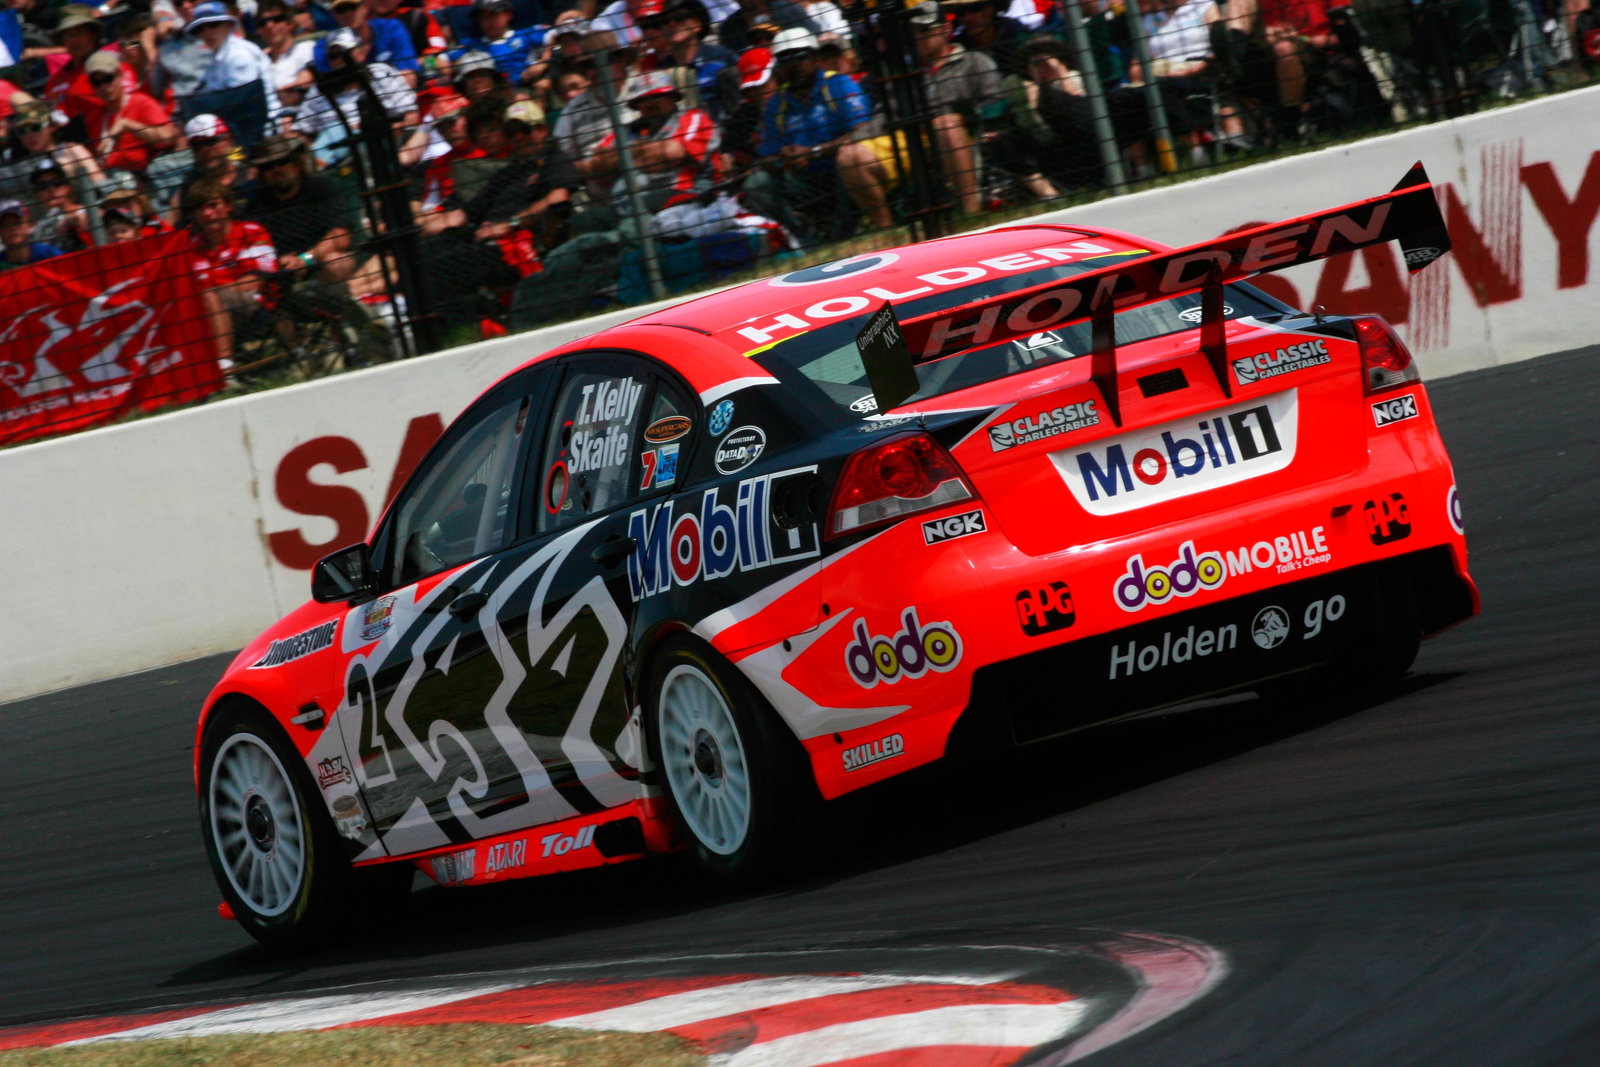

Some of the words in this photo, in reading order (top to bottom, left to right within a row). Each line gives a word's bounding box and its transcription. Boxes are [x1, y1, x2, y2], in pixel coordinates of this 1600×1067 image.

[736, 242, 1112, 344] HOLDEN
[920, 201, 1392, 359] HOLDEN
[858, 309, 892, 351] Unigraphics
[1254, 339, 1327, 369] CLASSIC
[1258, 353, 1331, 379] CARLECTABLES
[1013, 400, 1097, 434] CLASSIC
[1016, 415, 1100, 446] CARLECTABLES
[1372, 397, 1416, 424] NGK
[567, 425, 629, 475] Skaife
[717, 444, 765, 463] DATADT
[1076, 416, 1236, 501] Mobil
[1238, 410, 1274, 457] 1
[627, 473, 770, 602] Mobil
[923, 512, 983, 543] NGK
[1364, 494, 1411, 538] PPG
[1114, 542, 1225, 611] dodo
[1226, 526, 1329, 577] MOBILE
[1276, 560, 1301, 575] Talk's
[1302, 553, 1332, 570] Cheap
[1016, 583, 1075, 631] PPG
[248, 618, 339, 669] BRIDGESTONE
[846, 608, 961, 687] dodo
[1109, 623, 1238, 680] Holden
[1302, 594, 1346, 640] go
[346, 659, 394, 784] 2
[842, 733, 904, 771] SKILLED
[485, 838, 528, 874] ATARI
[540, 824, 598, 858] Toll
